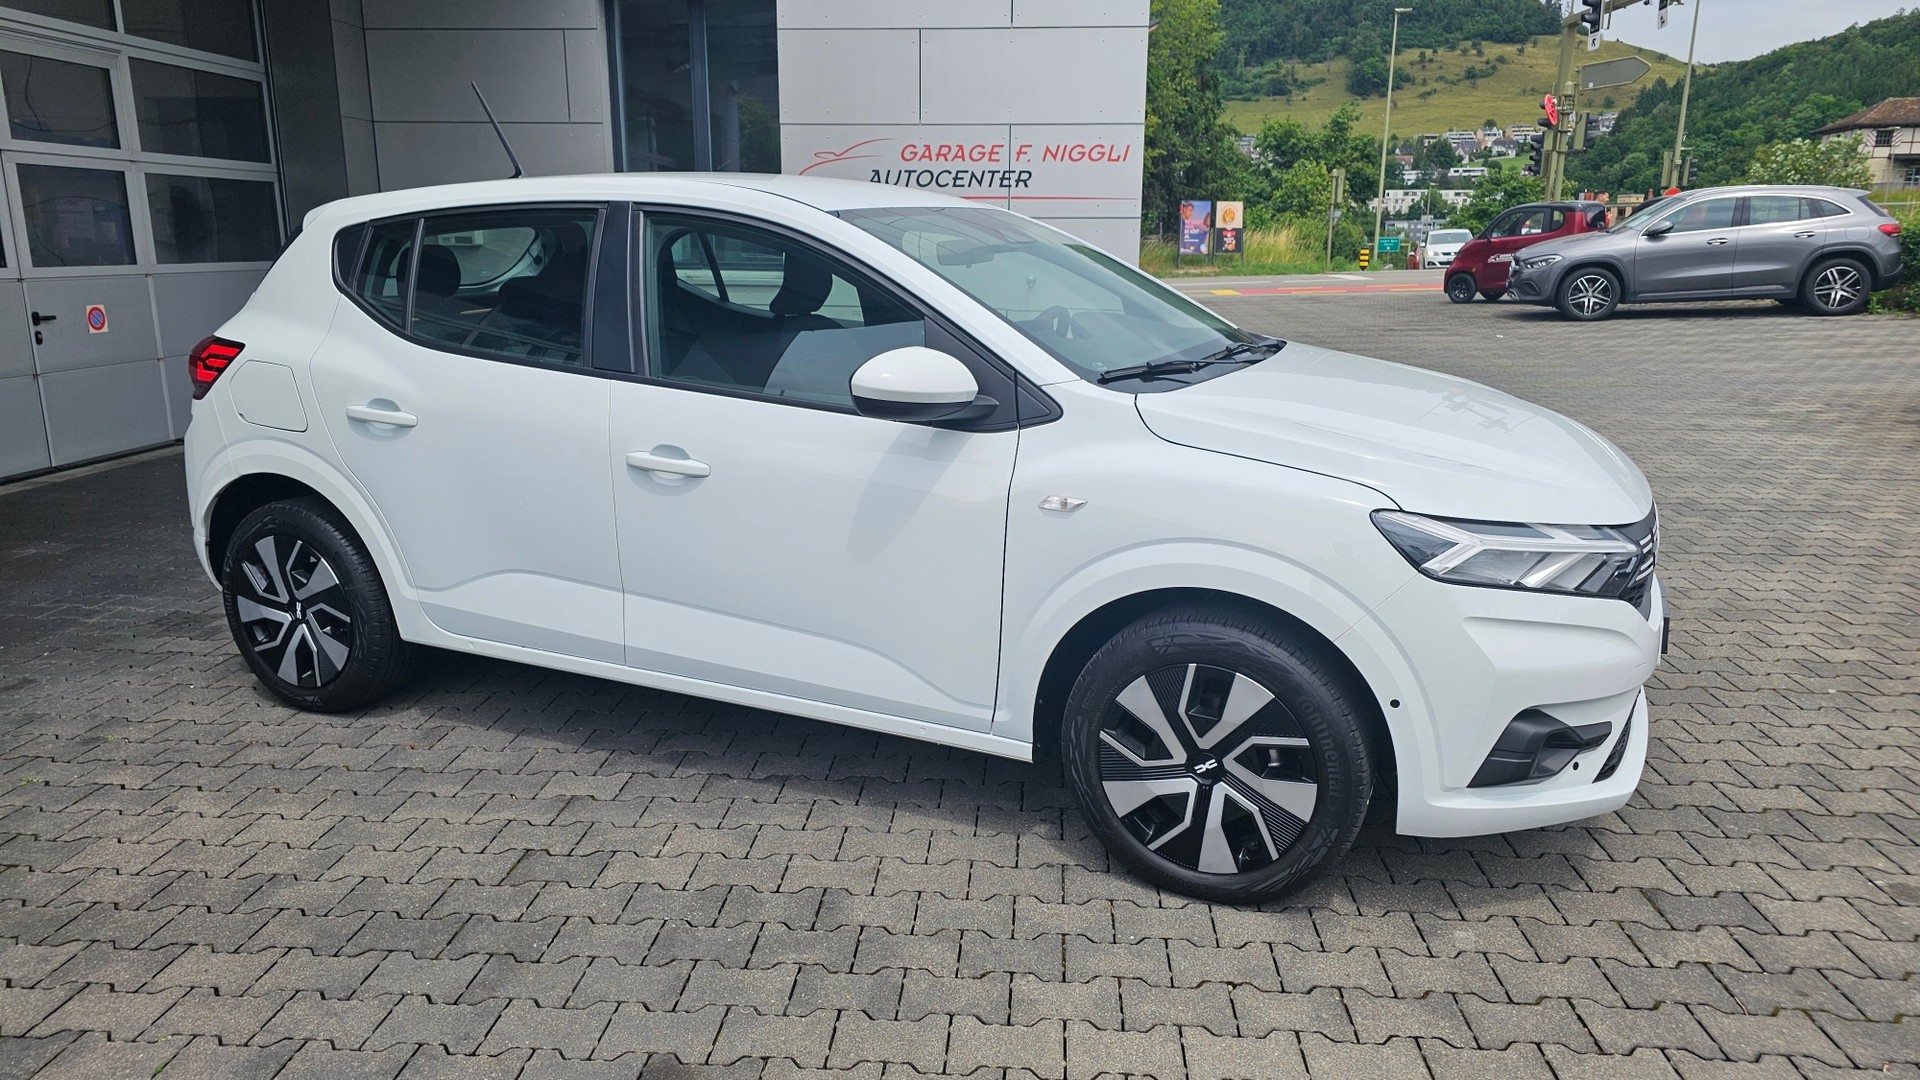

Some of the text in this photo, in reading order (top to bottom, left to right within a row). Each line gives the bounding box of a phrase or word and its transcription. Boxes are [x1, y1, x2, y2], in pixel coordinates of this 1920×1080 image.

[900, 143, 1131, 163] GARAGE F. NIGGLI
[869, 169, 1032, 188] AUTOCENTER
